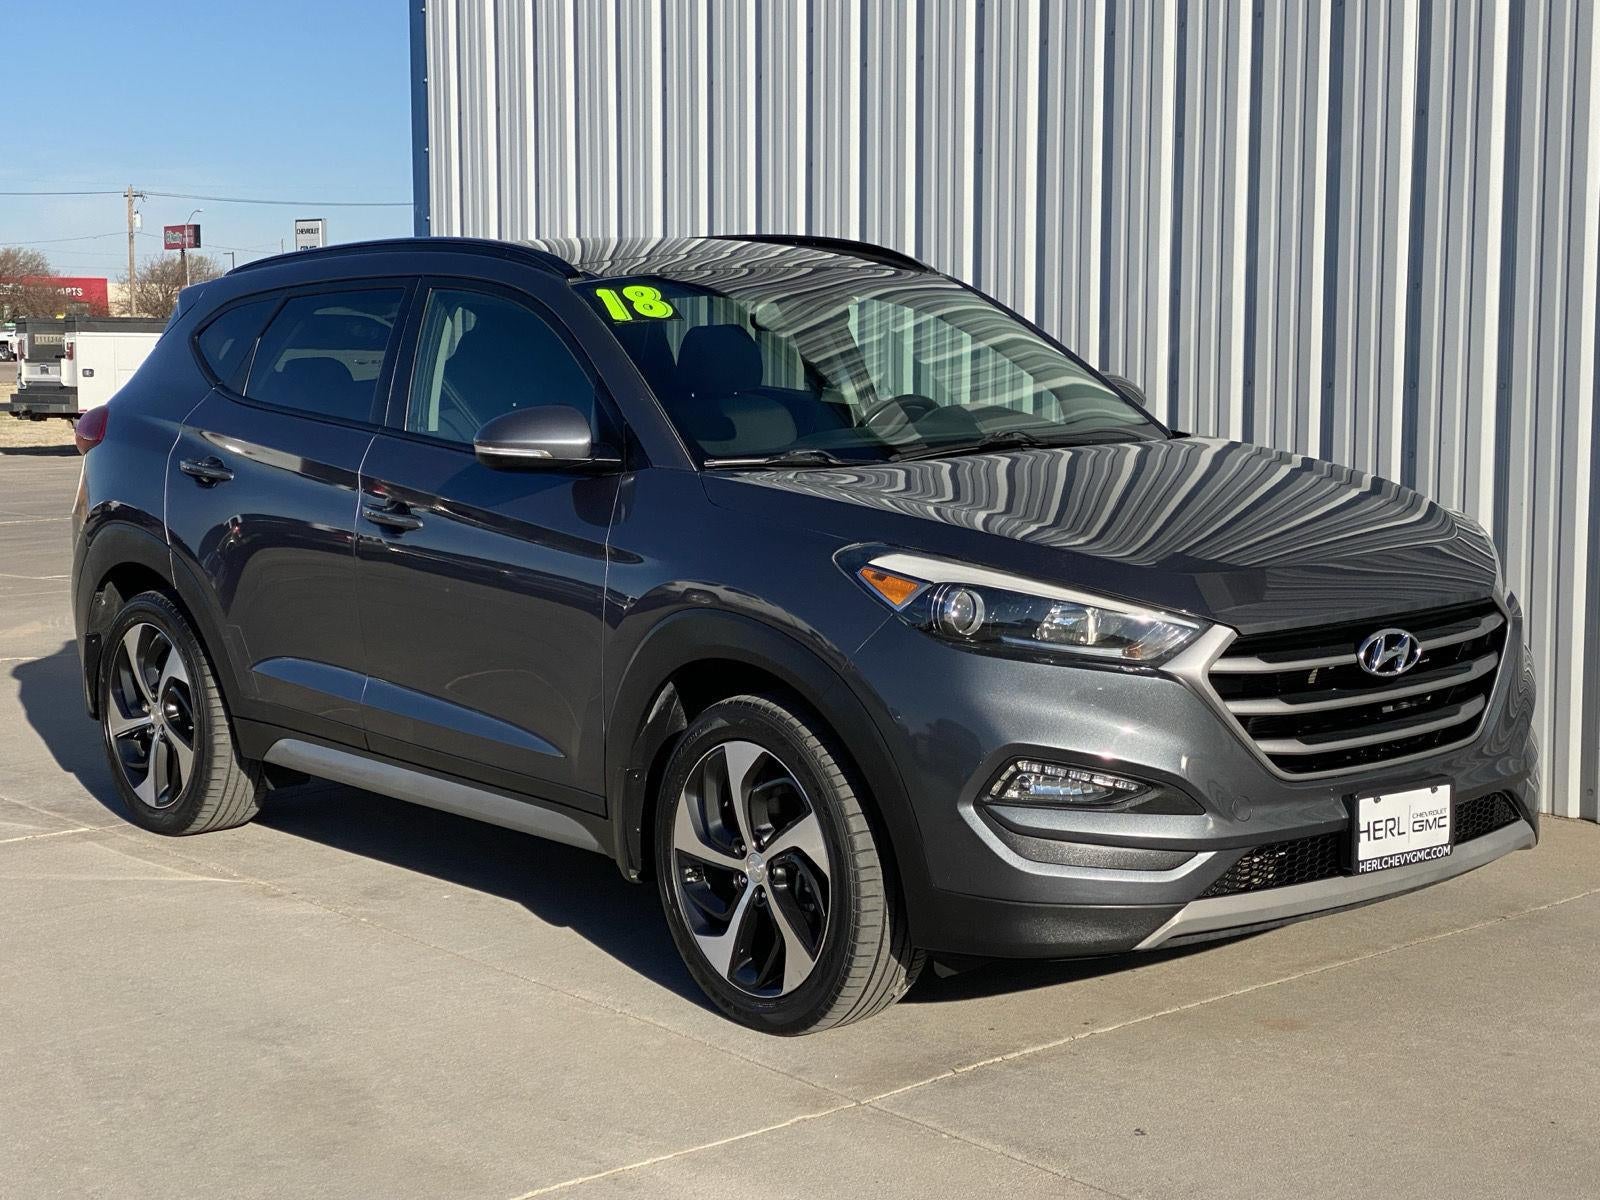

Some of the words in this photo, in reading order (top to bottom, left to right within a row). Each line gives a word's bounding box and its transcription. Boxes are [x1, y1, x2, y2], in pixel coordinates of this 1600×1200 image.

[596, 285, 673, 321] 18
[1412, 807, 1448, 820] CHEVROLET
[1412, 815, 1447, 833] GMC
[1360, 816, 1406, 842] HERL
[1359, 844, 1451, 873] HERLCHEVYGMC.COM
